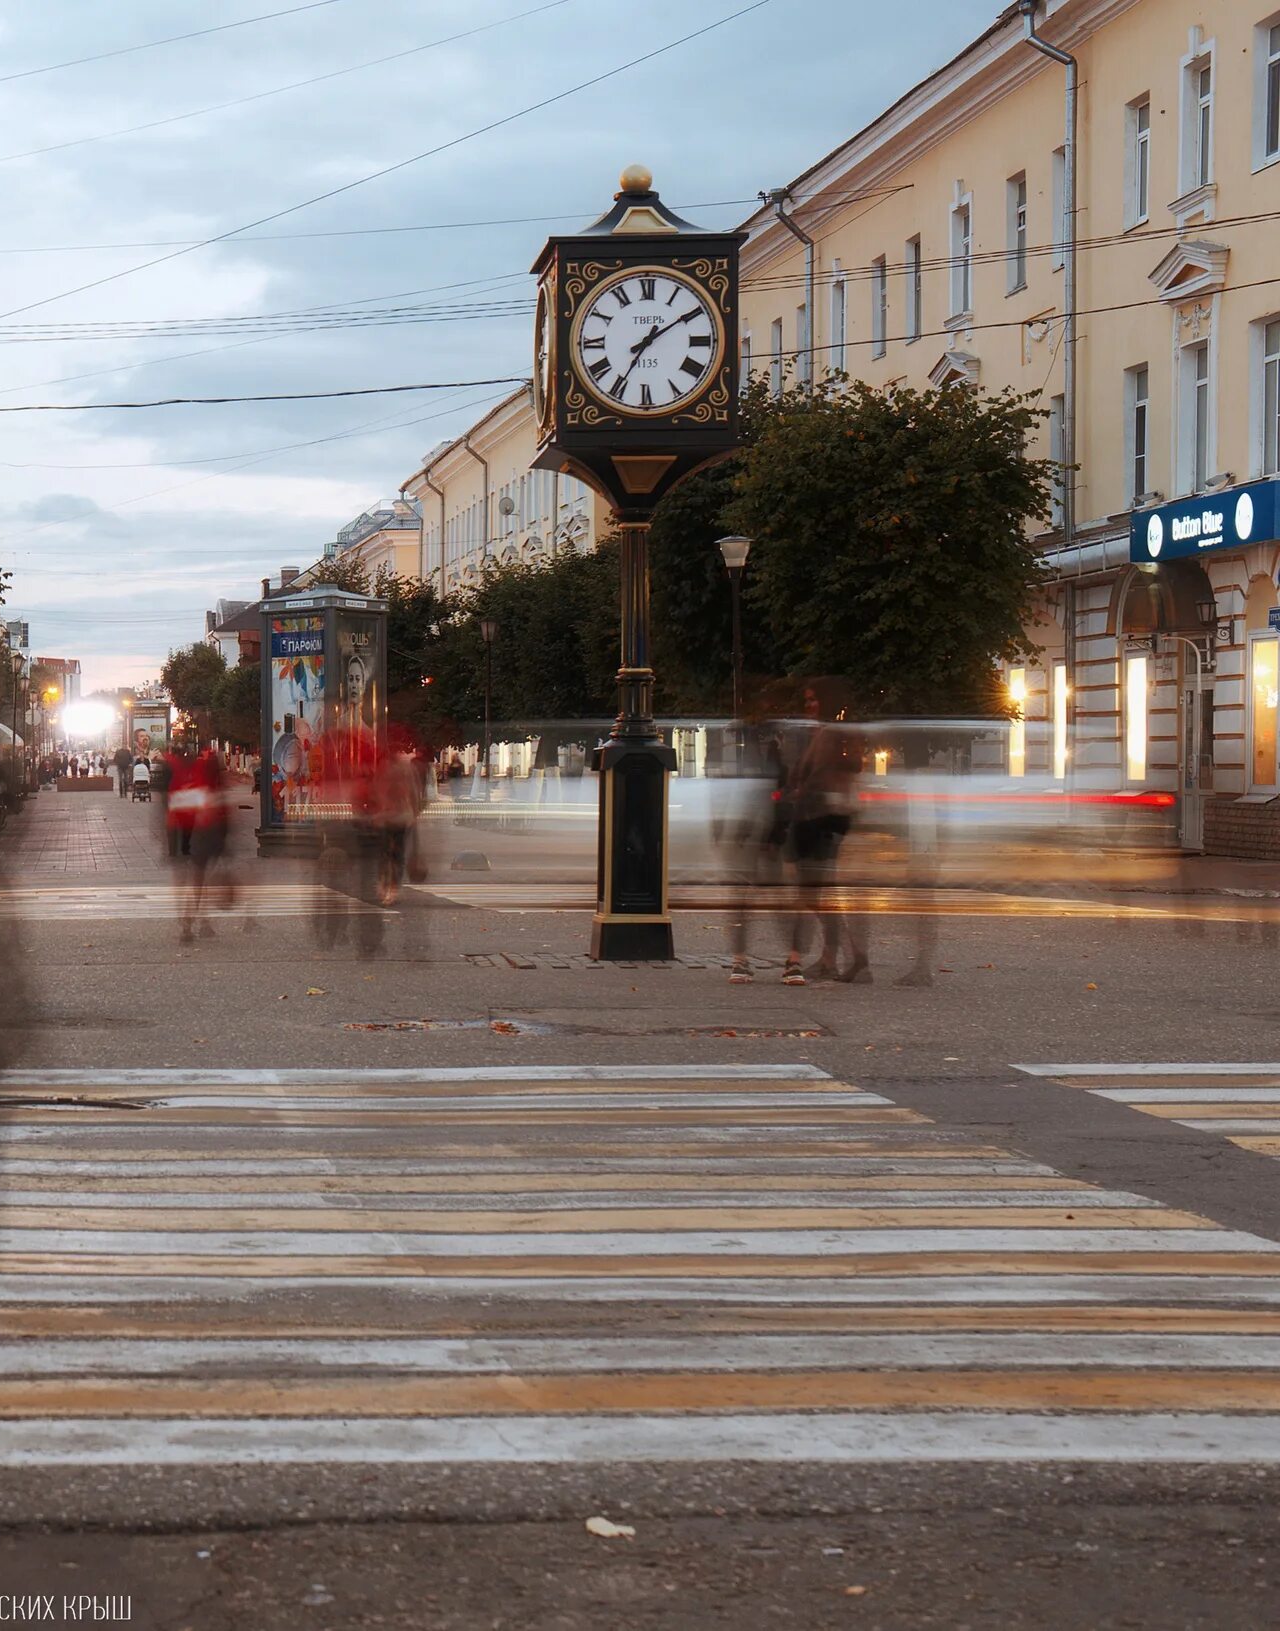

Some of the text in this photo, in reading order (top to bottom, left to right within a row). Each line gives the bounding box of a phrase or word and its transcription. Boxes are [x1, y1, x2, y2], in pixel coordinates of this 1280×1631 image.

[632, 316, 665, 325] ТВЕРЬ
[637, 359, 658, 369] 1135
[1172, 516, 1201, 541] Button
[1202, 510, 1223, 535] Blue
